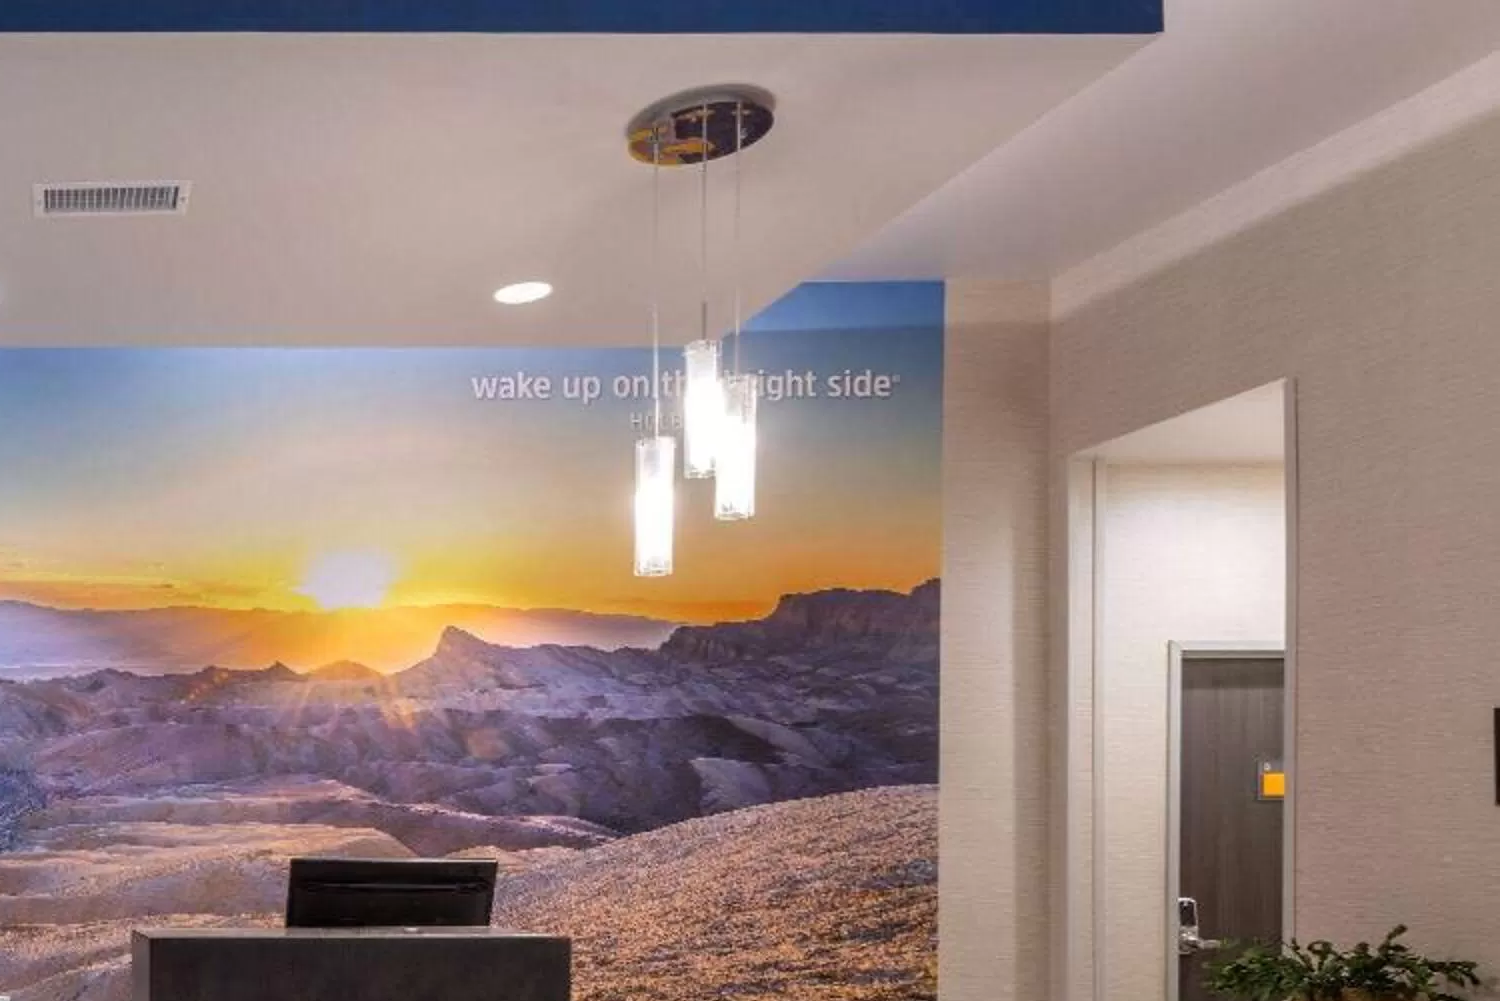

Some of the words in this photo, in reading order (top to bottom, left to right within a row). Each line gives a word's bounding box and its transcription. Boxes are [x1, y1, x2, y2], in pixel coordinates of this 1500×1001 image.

[471, 372, 551, 399] wake
[563, 375, 600, 405] up
[613, 374, 649, 398] on
